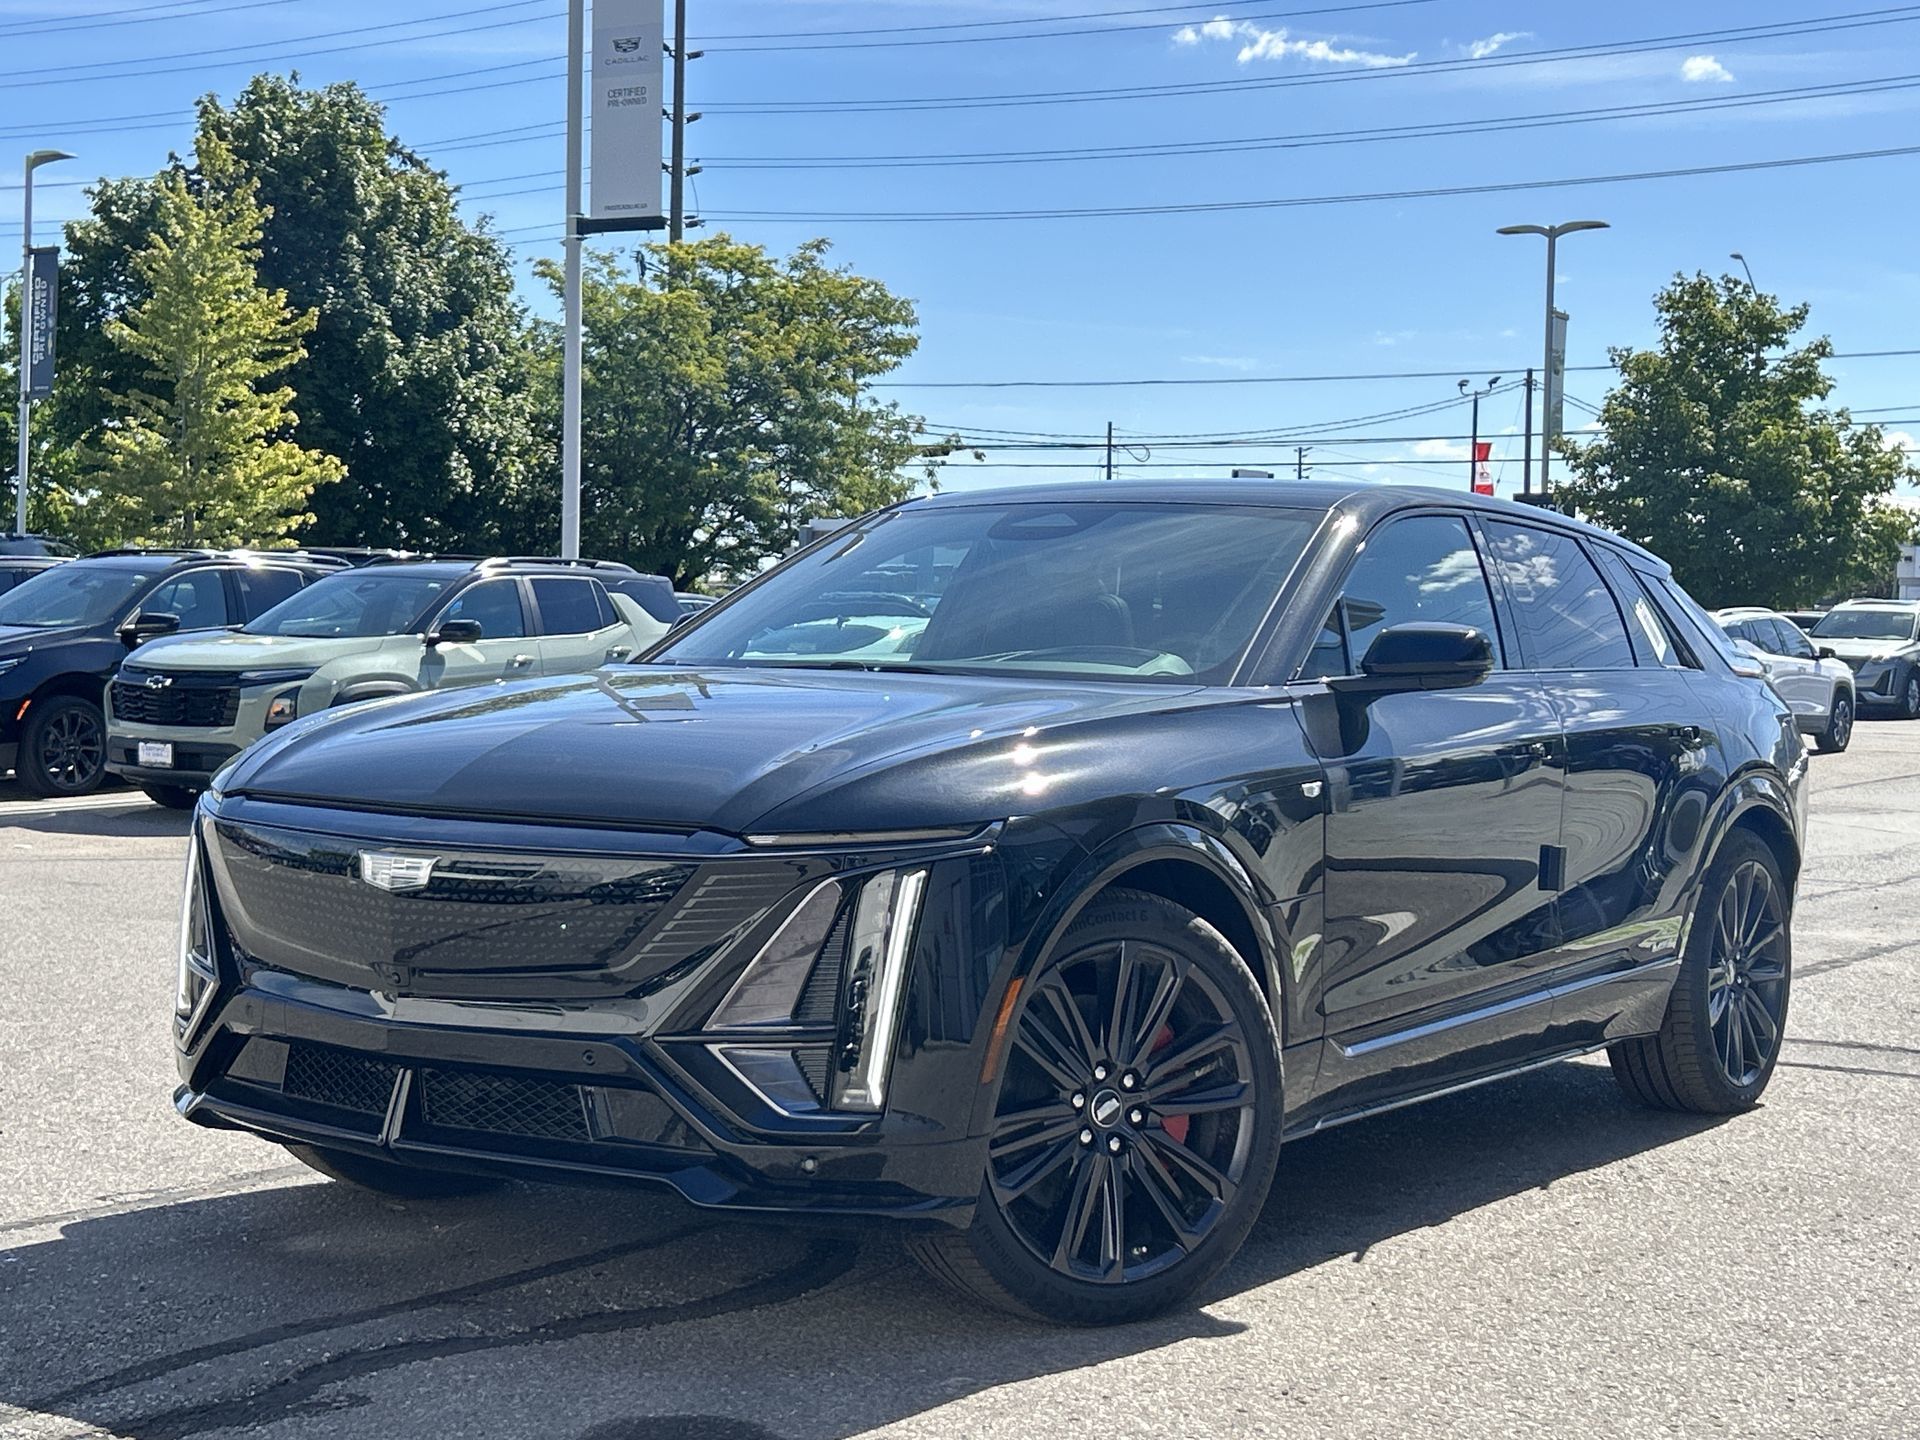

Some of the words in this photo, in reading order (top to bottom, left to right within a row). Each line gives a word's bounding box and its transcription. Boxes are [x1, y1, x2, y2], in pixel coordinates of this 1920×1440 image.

[604, 55, 650, 66] CADILLAC
[607, 86, 647, 98] CERTIFIED
[608, 97, 648, 107] PRE-OWNED
[33, 277, 42, 365] CERTIFIED
